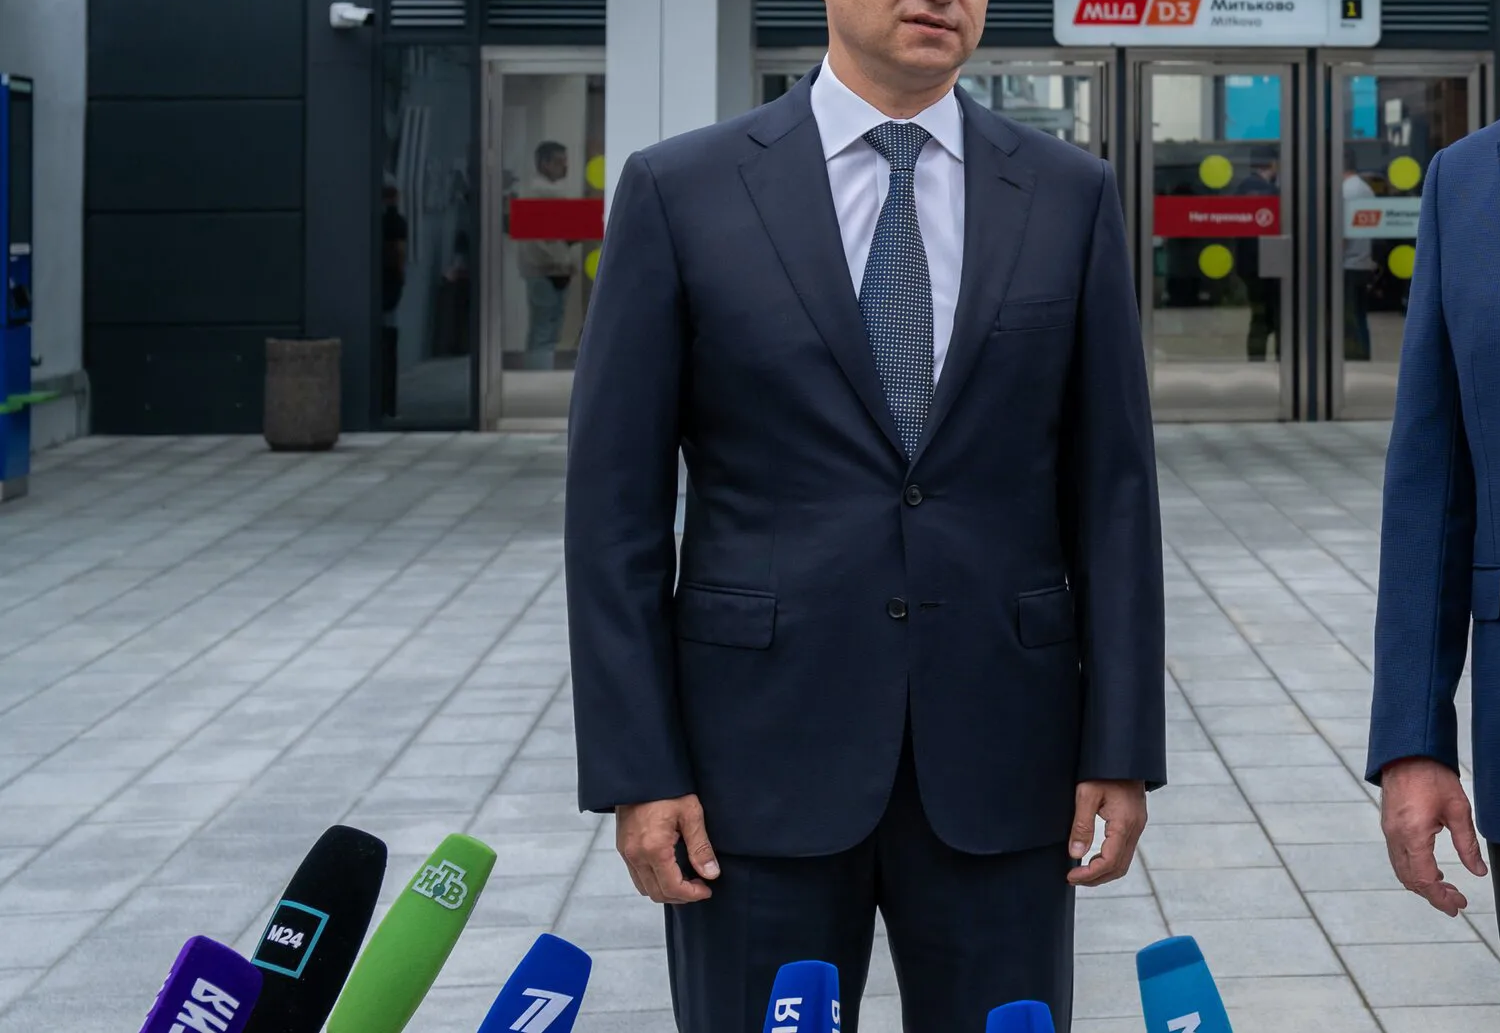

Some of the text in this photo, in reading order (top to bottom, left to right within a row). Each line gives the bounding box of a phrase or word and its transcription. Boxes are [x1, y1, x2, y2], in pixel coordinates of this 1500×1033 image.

[1082, 1, 1192, 22] МЦД D3
[412, 859, 467, 910] НТВ
